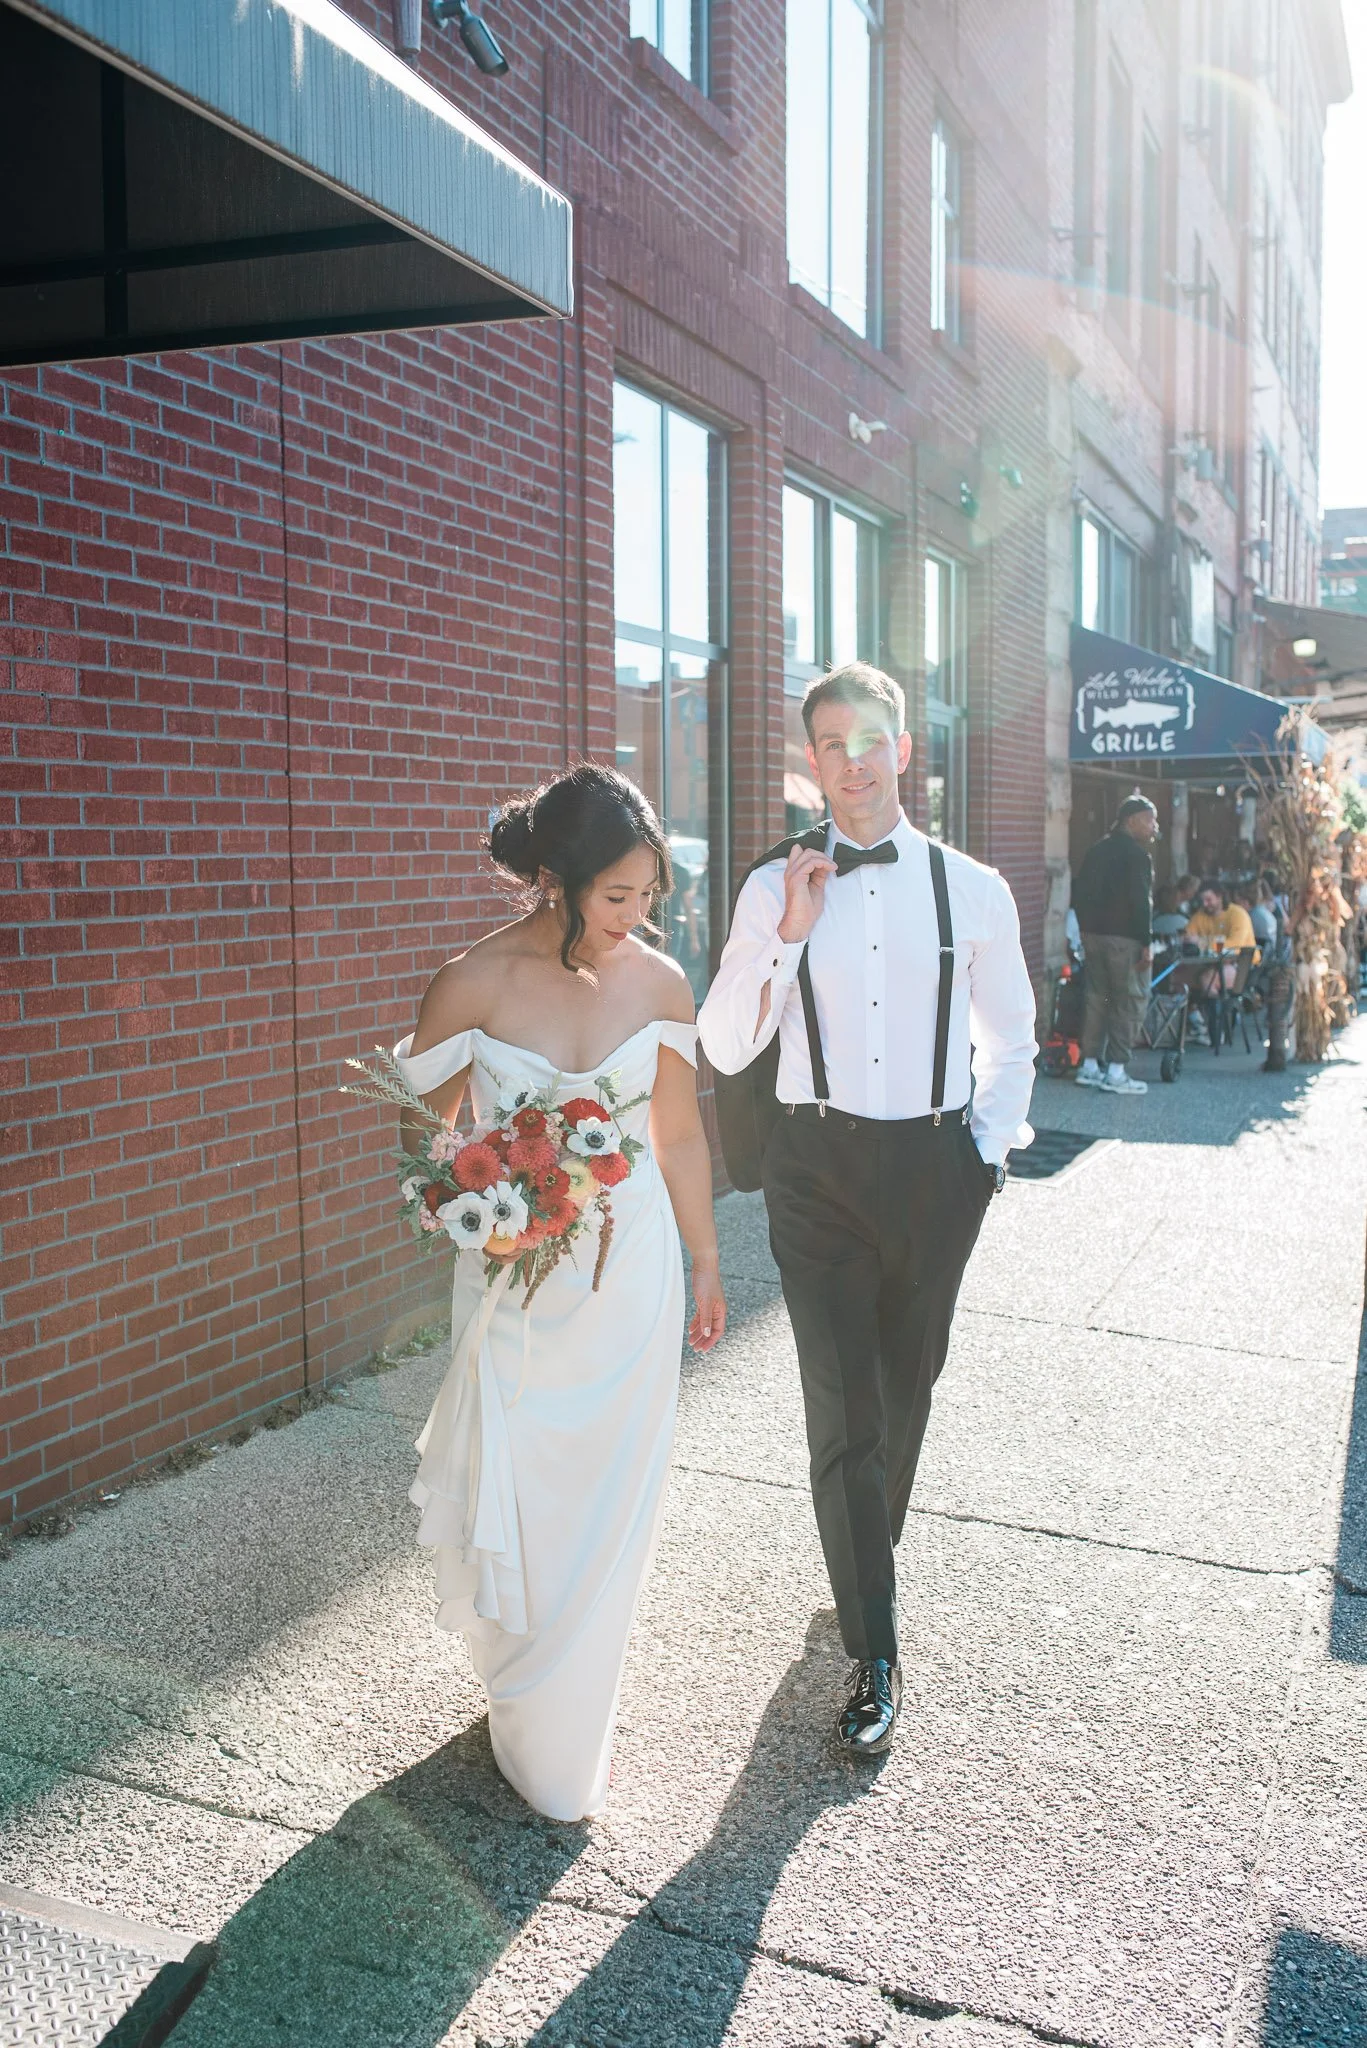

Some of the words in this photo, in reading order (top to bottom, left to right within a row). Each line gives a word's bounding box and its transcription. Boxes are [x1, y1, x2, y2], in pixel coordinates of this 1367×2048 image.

[1085, 688, 1119, 699] WILD
[1125, 686, 1184, 699] ALASKAN
[1091, 730, 1176, 754] GRILLE
